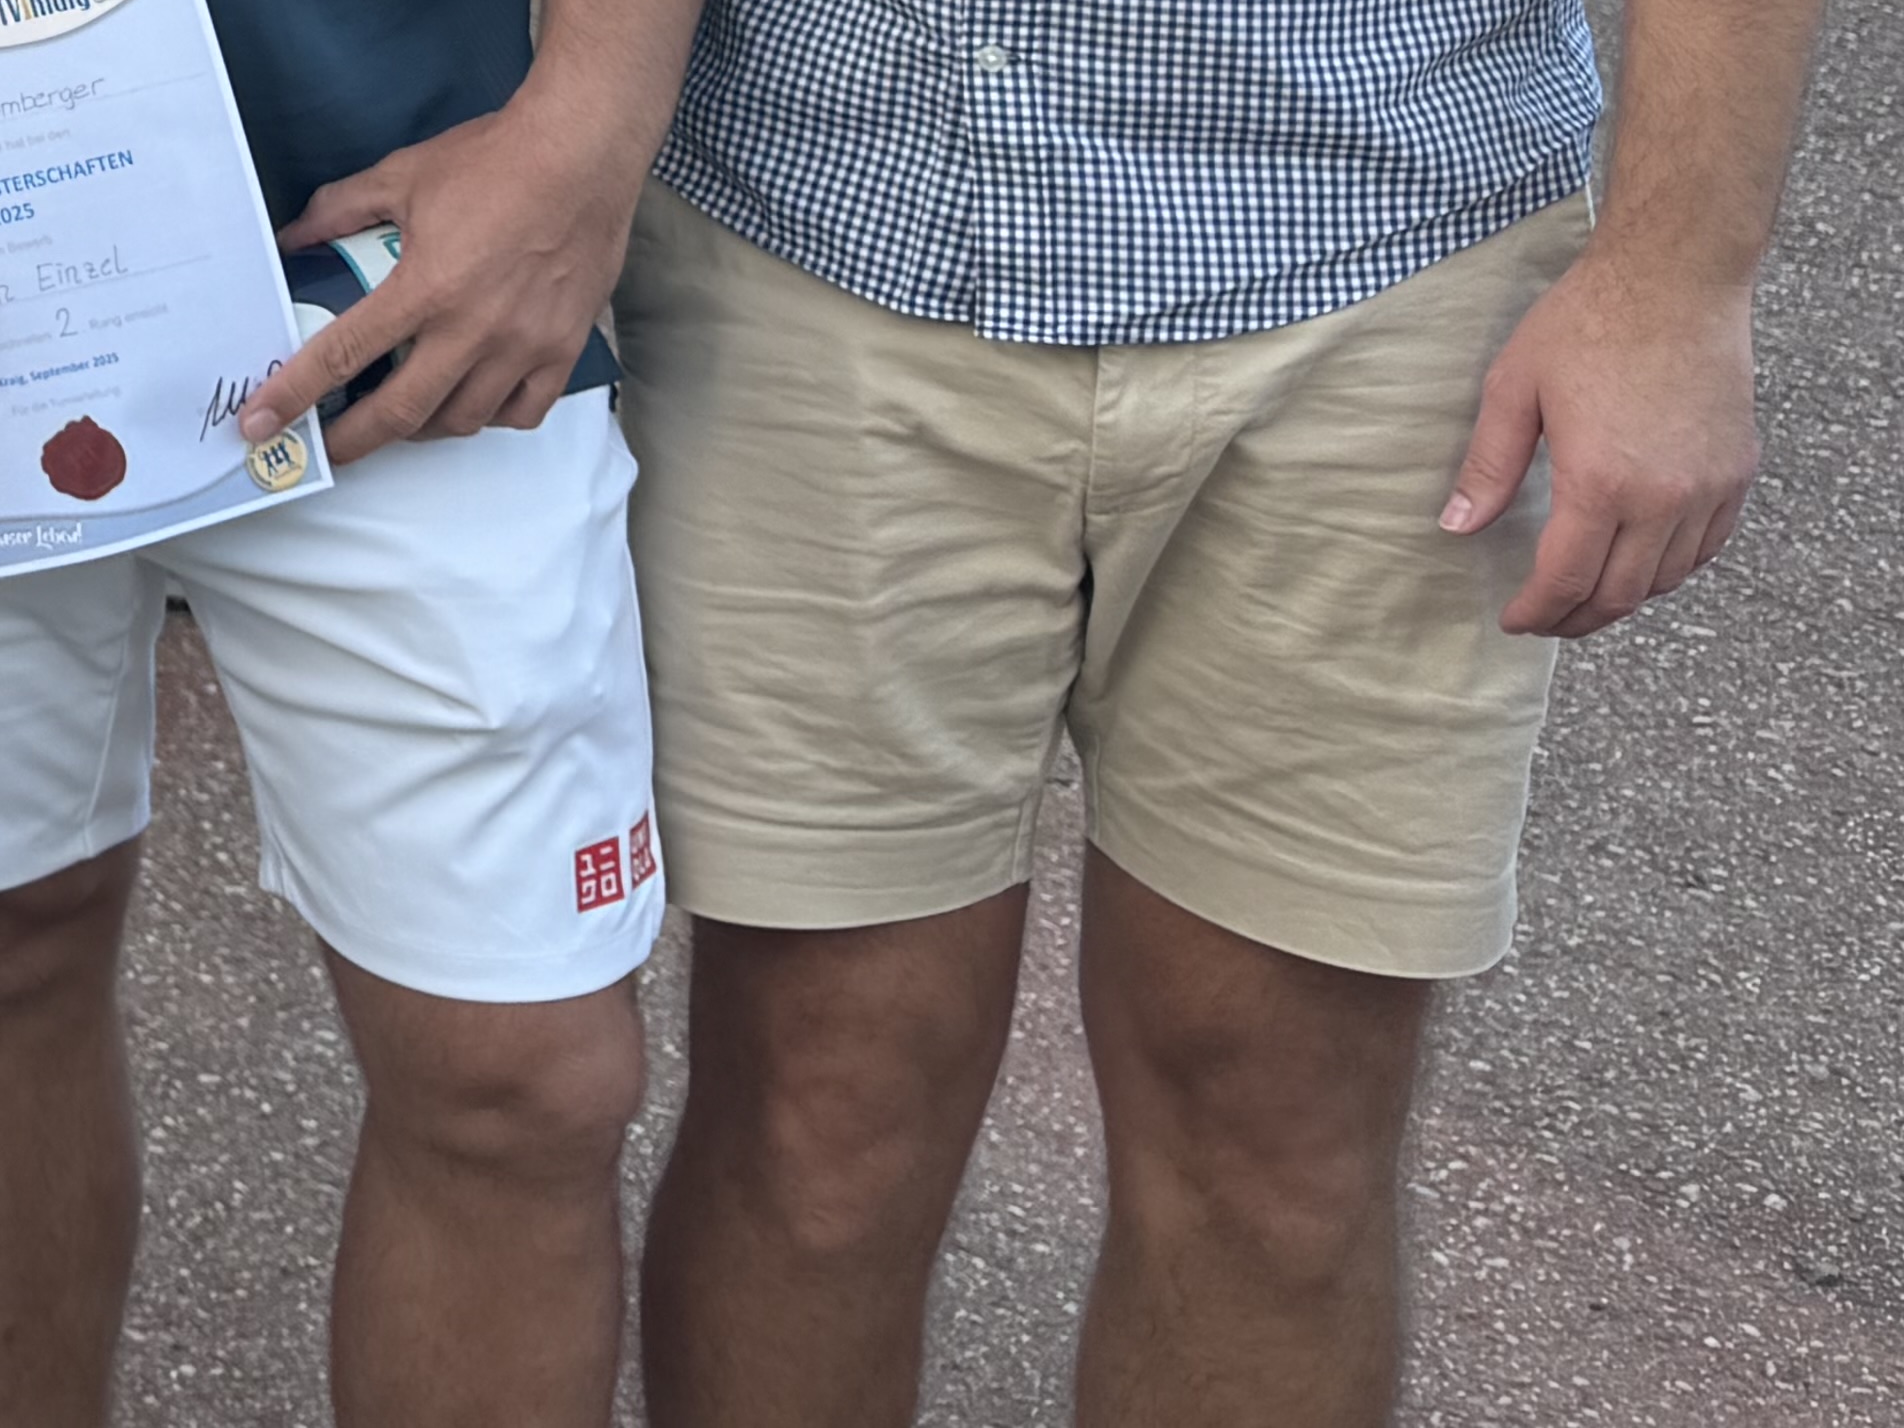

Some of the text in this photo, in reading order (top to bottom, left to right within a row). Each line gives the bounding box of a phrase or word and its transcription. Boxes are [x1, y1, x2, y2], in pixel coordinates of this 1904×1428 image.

[35, 244, 129, 293] Einzel
[30, 360, 90, 382] September
[93, 352, 120, 368] 2025
